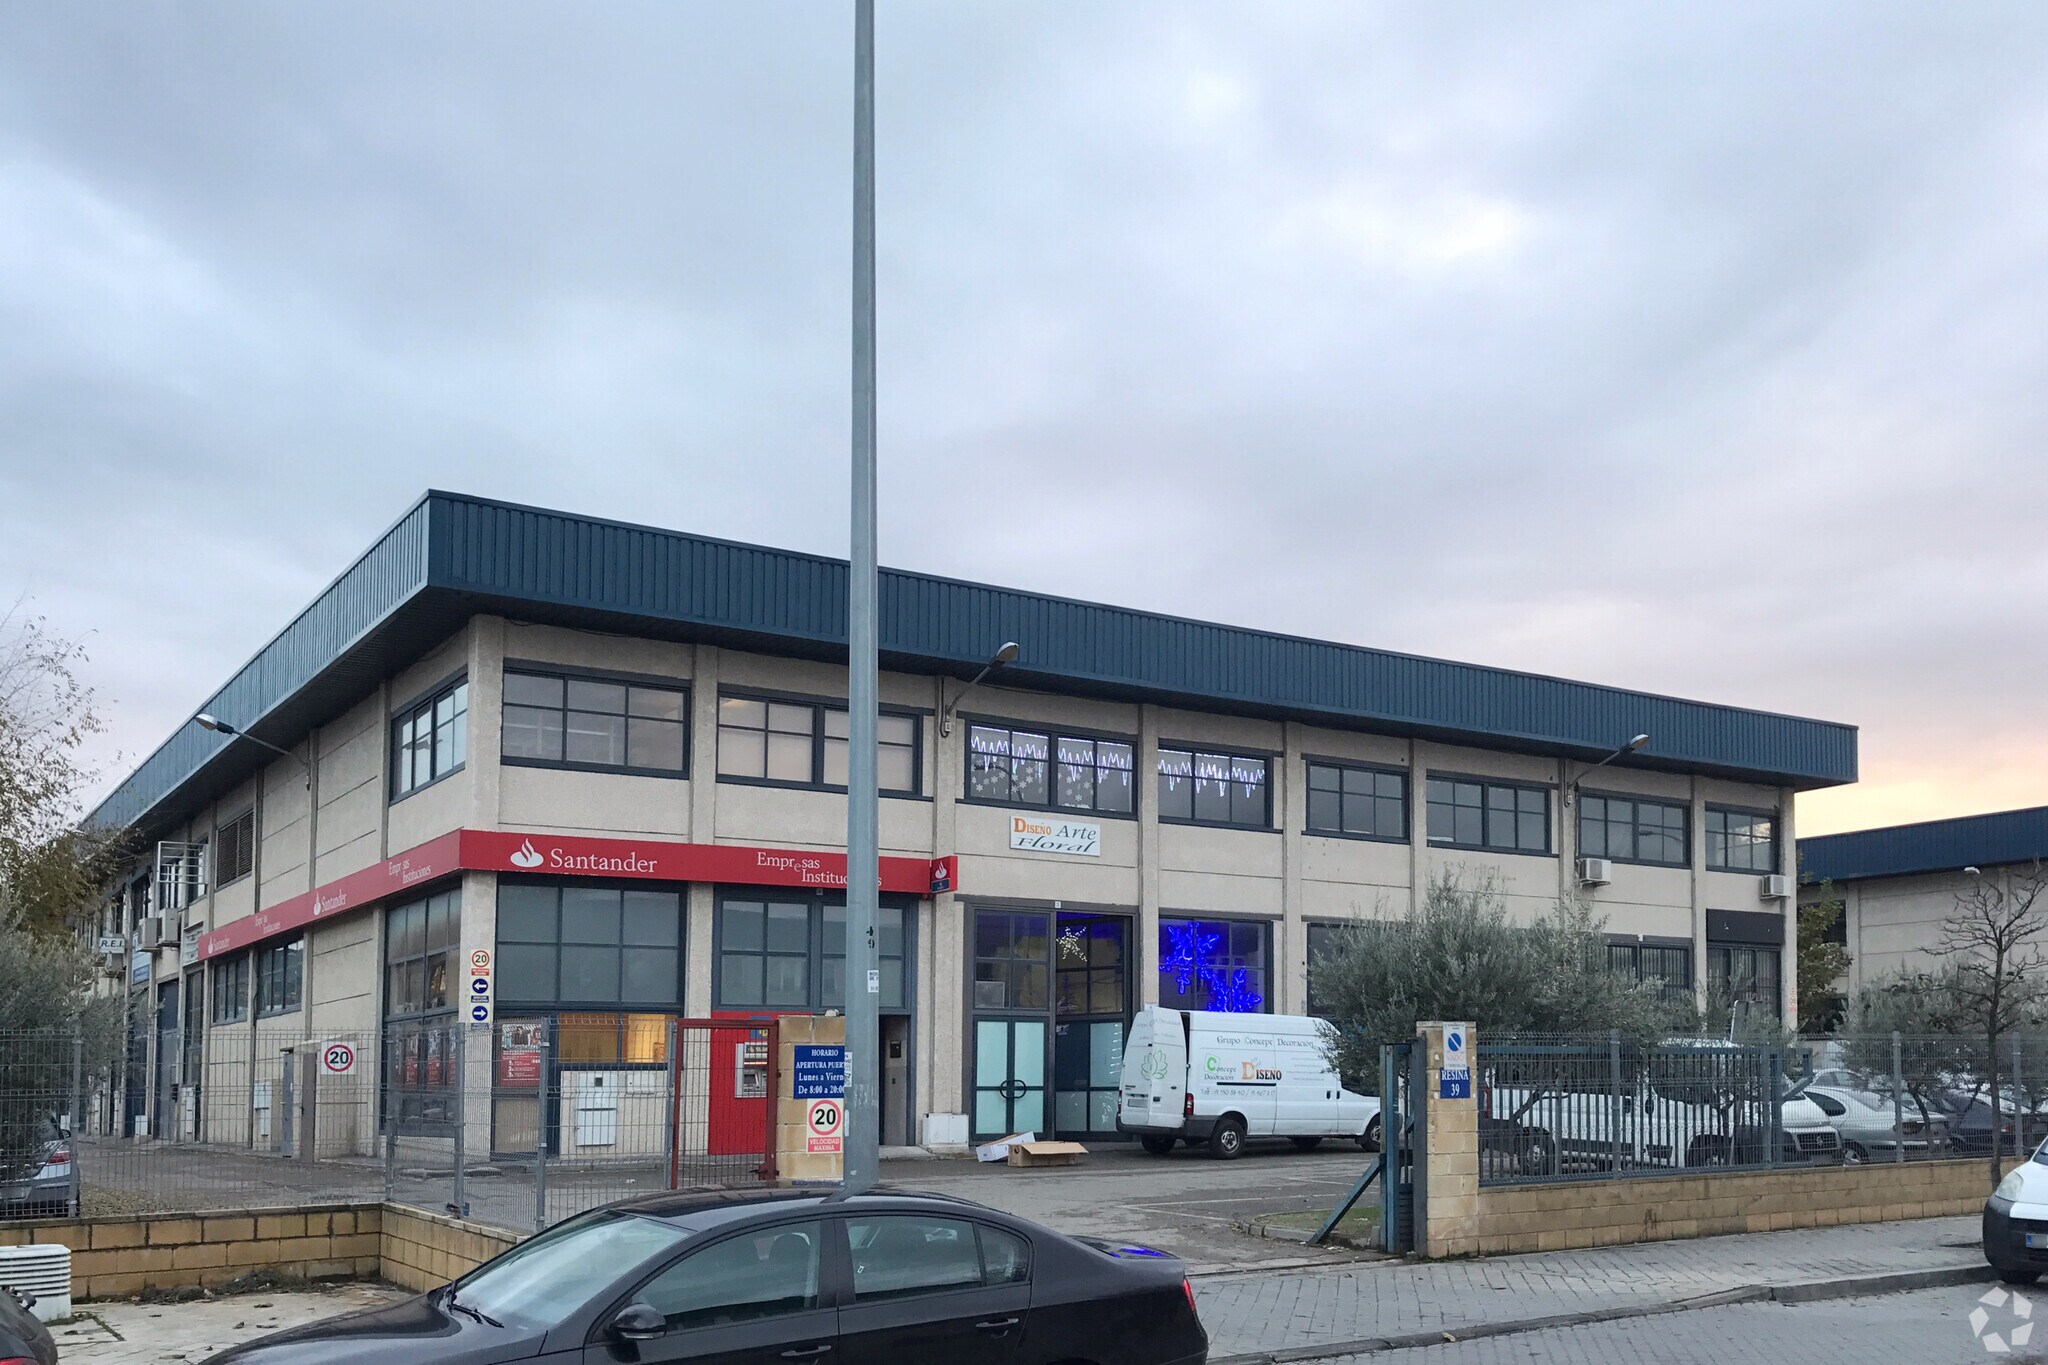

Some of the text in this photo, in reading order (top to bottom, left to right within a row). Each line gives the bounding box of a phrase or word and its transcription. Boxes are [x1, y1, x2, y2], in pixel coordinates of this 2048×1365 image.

[1056, 825, 1097, 841] Arte
[1014, 835, 1096, 853] Floral
[550, 847, 658, 873] Santander
[757, 851, 821, 872] Empresas
[321, 889, 347, 912] Santander
[101, 939, 124, 948] R.E.I.
[475, 954, 487, 963] 20
[330, 1051, 349, 1064] 20
[811, 1049, 839, 1057] HORARIO
[796, 1061, 827, 1069] APERTURA
[798, 1073, 819, 1082] Lunes
[1441, 1070, 1469, 1081] RESINA
[798, 1085, 807, 1094] De
[809, 1085, 823, 1094] 8:00
[1450, 1083, 1460, 1096] 39
[814, 1108, 837, 1125] 20
